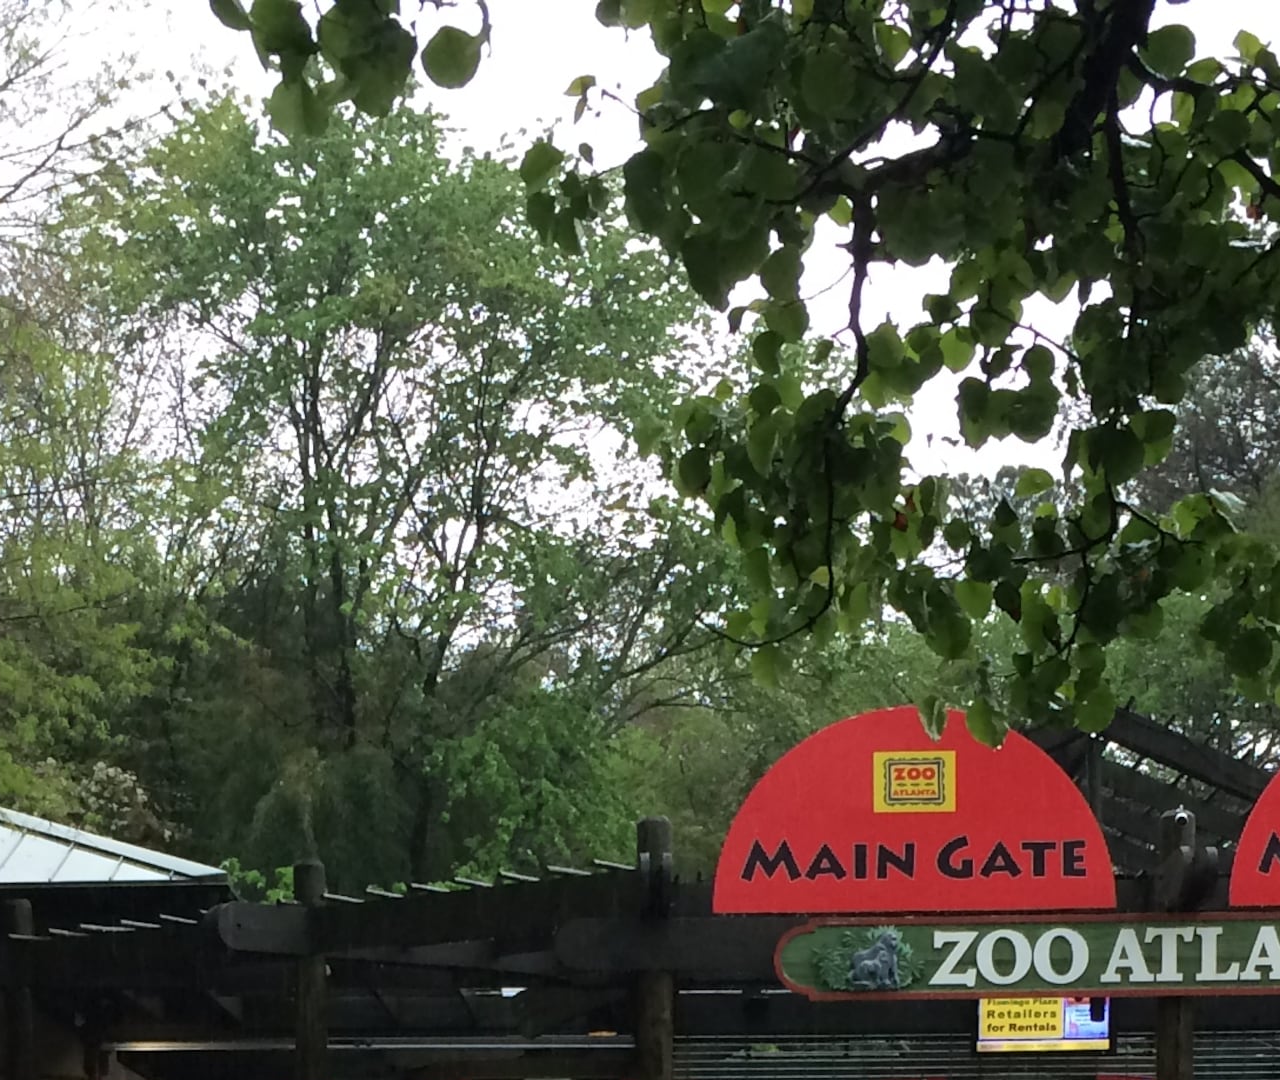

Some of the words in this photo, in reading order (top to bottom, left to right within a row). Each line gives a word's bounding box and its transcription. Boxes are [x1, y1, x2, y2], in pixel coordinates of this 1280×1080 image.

[893, 767, 936, 781] ZOO
[741, 839, 916, 881] MAIN
[936, 835, 1087, 880] GATE
[928, 927, 1090, 987] ZOO
[986, 1009, 1057, 1019] Retailers
[987, 1023, 1005, 1032] for
[1009, 1023, 1057, 1032] Rentals
